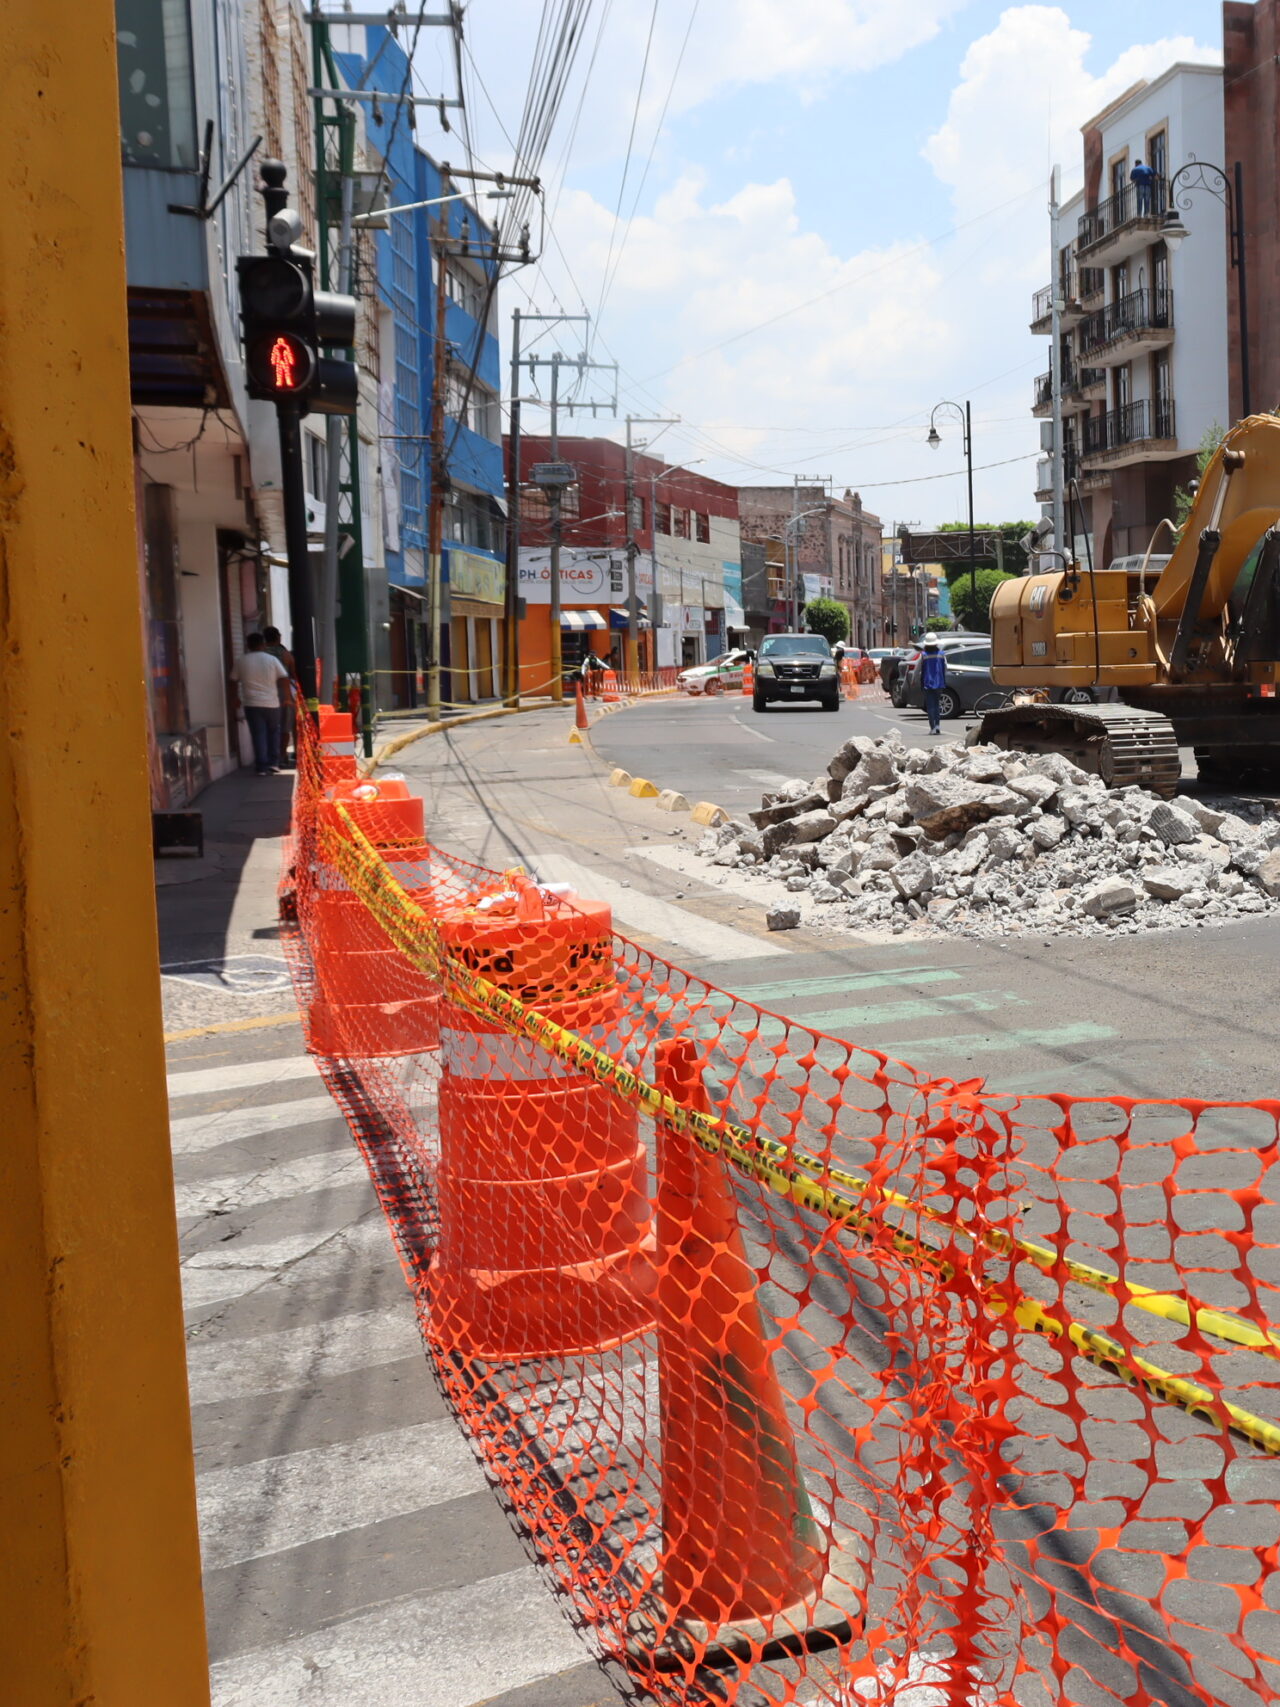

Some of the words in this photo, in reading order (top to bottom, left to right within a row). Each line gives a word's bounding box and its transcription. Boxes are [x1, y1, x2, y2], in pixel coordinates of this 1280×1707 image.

[519, 570, 536, 579] PH
[540, 567, 593, 580] ÓTICAS
[1030, 586, 1046, 610] CAT
